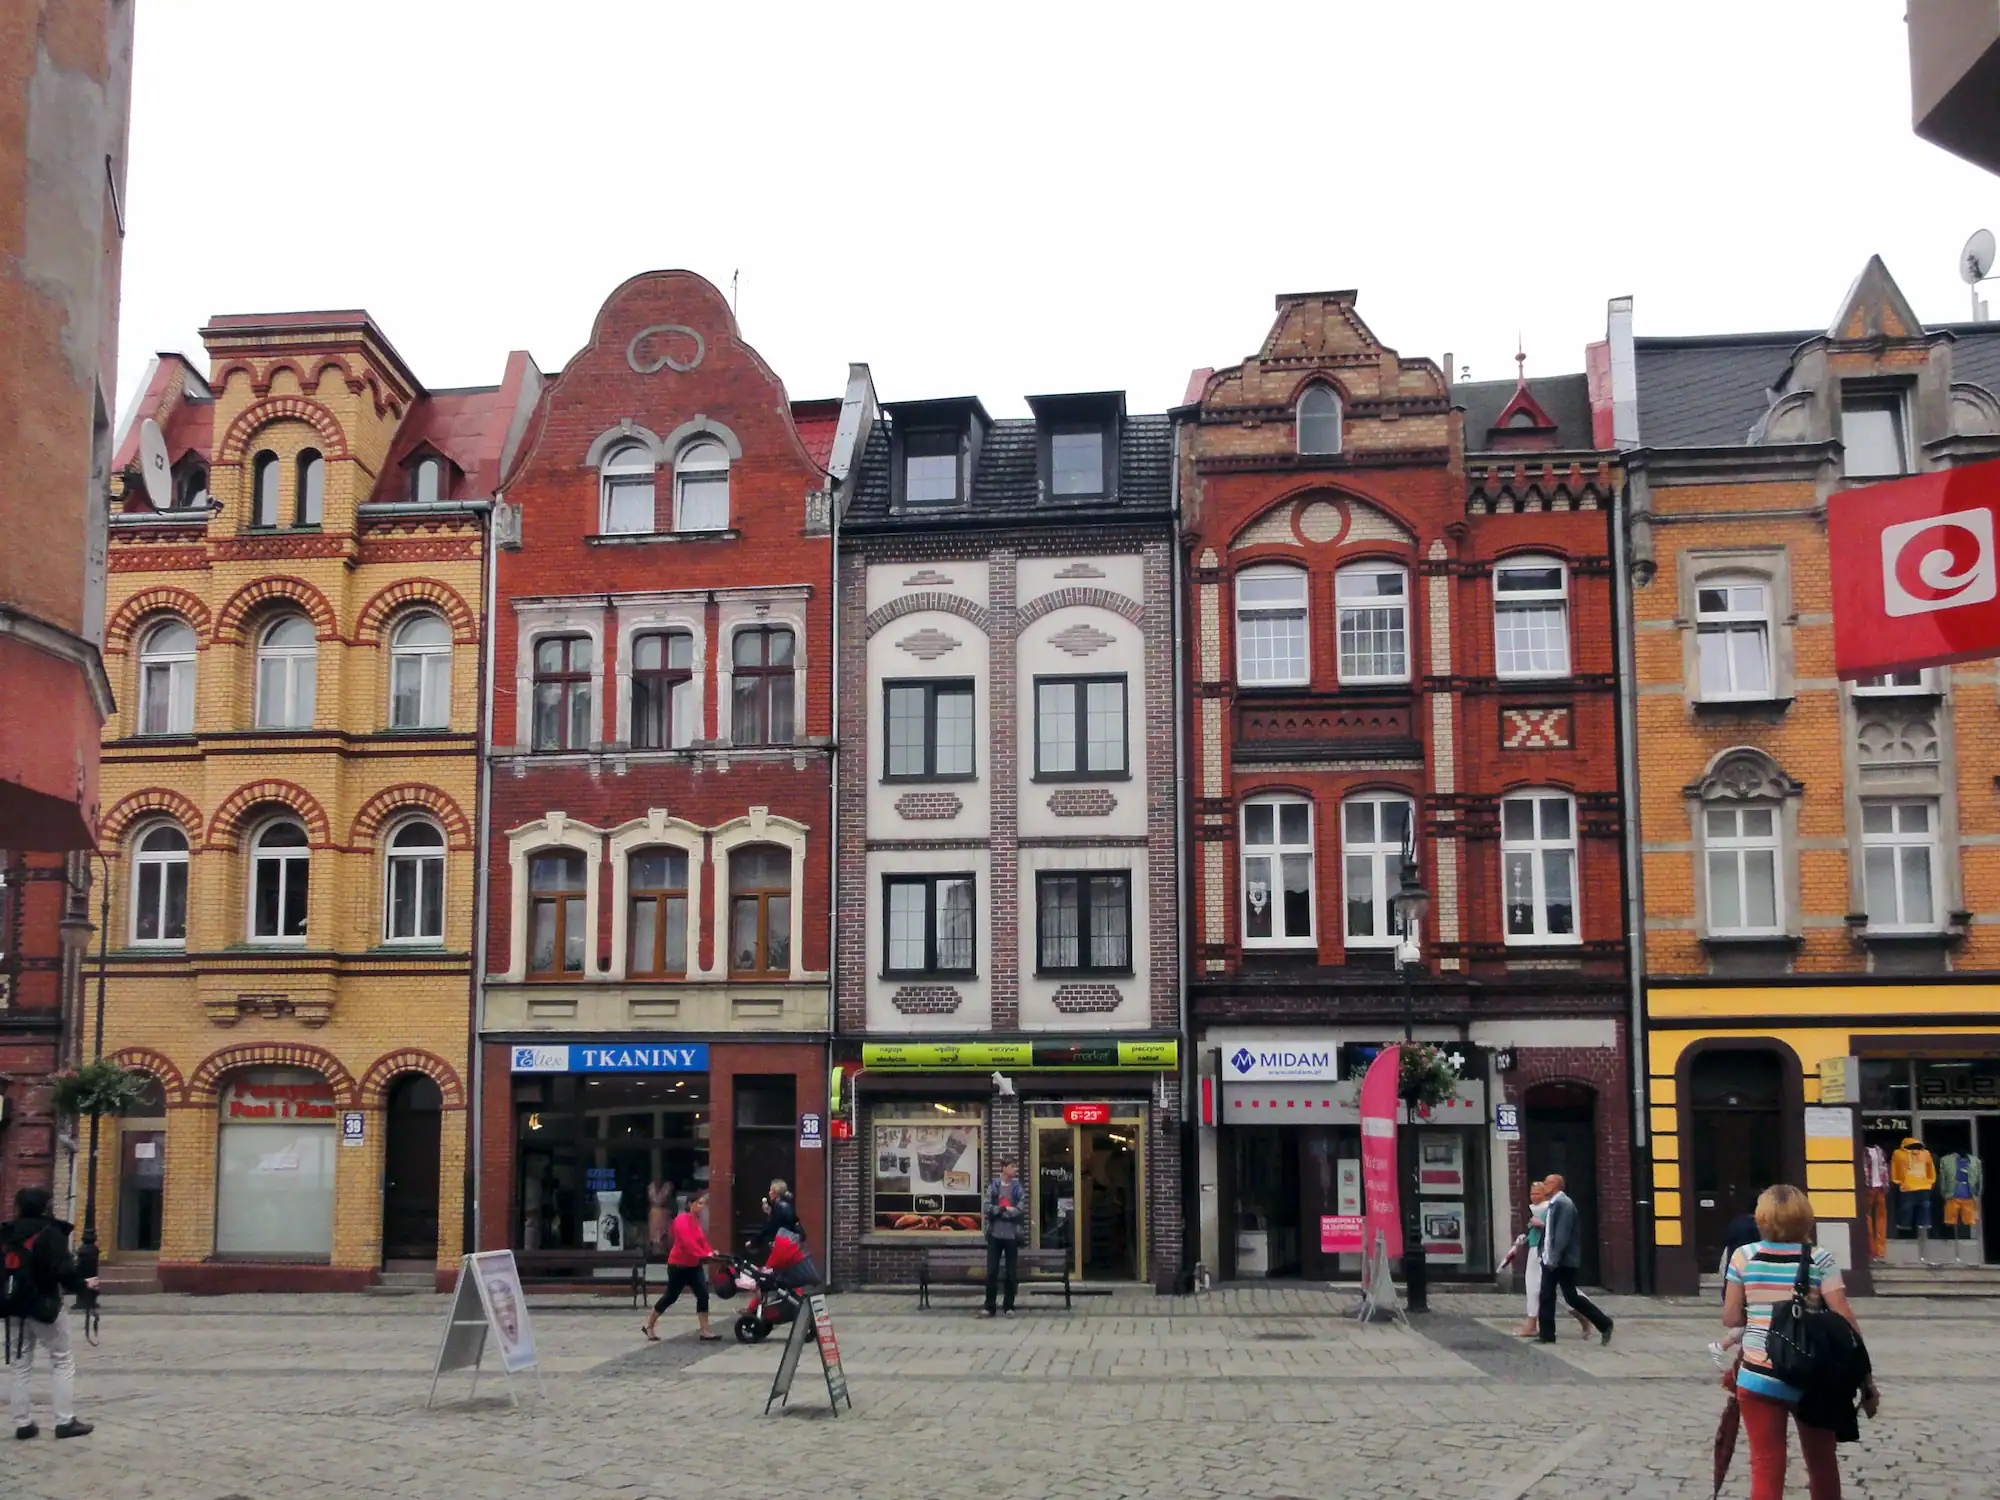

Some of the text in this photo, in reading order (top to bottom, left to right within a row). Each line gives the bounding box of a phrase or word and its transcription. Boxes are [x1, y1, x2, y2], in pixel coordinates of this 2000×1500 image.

[581, 1049, 697, 1067] TKANINY
[1260, 1052, 1329, 1067] MIDAM
[229, 1101, 276, 1117] Pani
[1500, 1111, 1516, 1126] 36
[346, 1120, 361, 1133] 39
[803, 1120, 819, 1134] 38
[1041, 1167, 1066, 1176] Fresh
